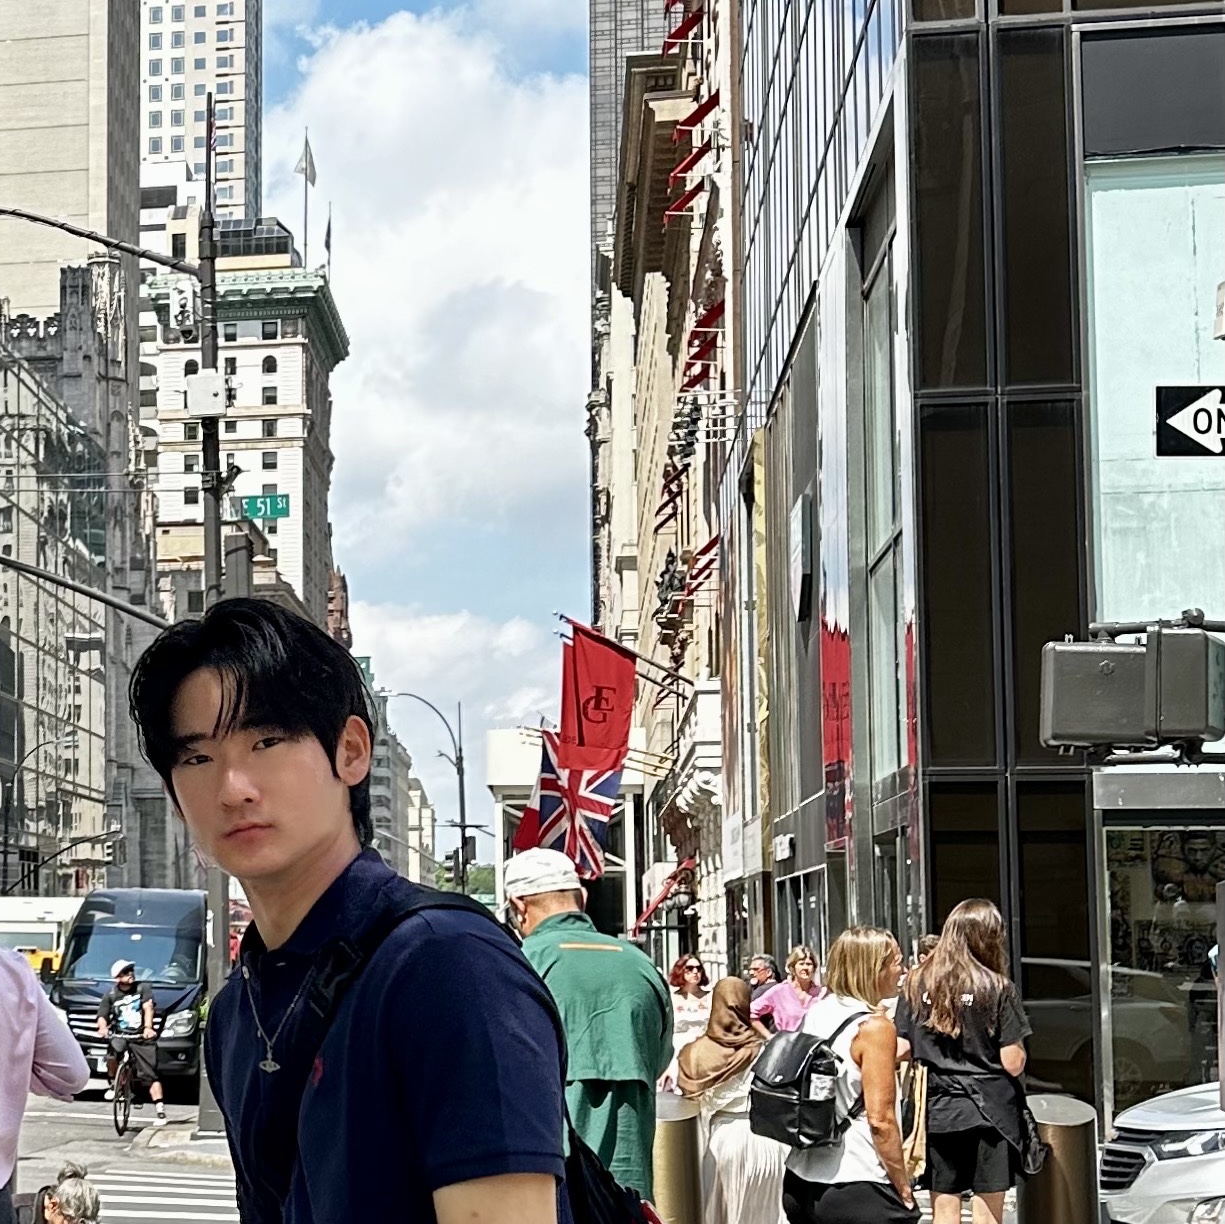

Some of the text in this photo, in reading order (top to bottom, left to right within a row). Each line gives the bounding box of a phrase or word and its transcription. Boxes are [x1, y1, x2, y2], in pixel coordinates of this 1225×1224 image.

[242, 496, 287, 516] E 51 St
